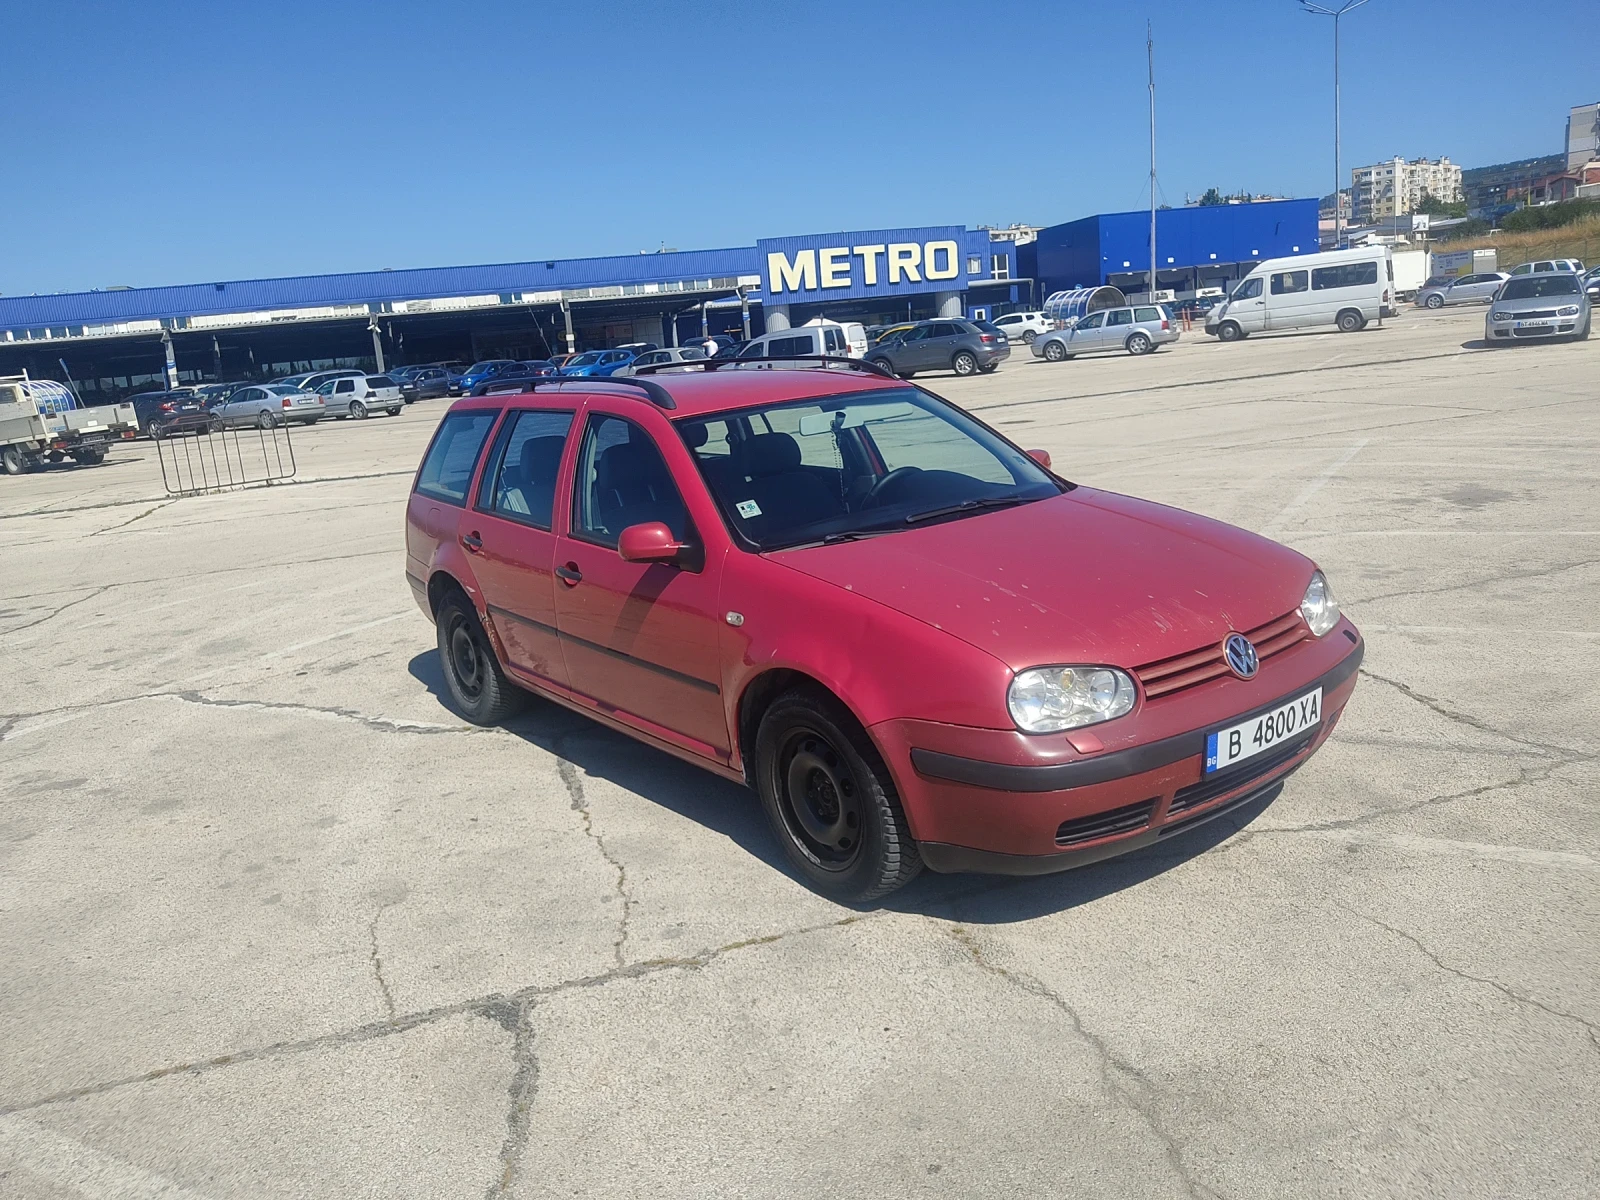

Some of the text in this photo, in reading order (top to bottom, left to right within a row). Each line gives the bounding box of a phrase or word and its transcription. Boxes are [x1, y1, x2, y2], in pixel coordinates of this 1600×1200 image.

[767, 240, 959, 293] METRO
[1206, 693, 1318, 767] BG B 4800 XA
